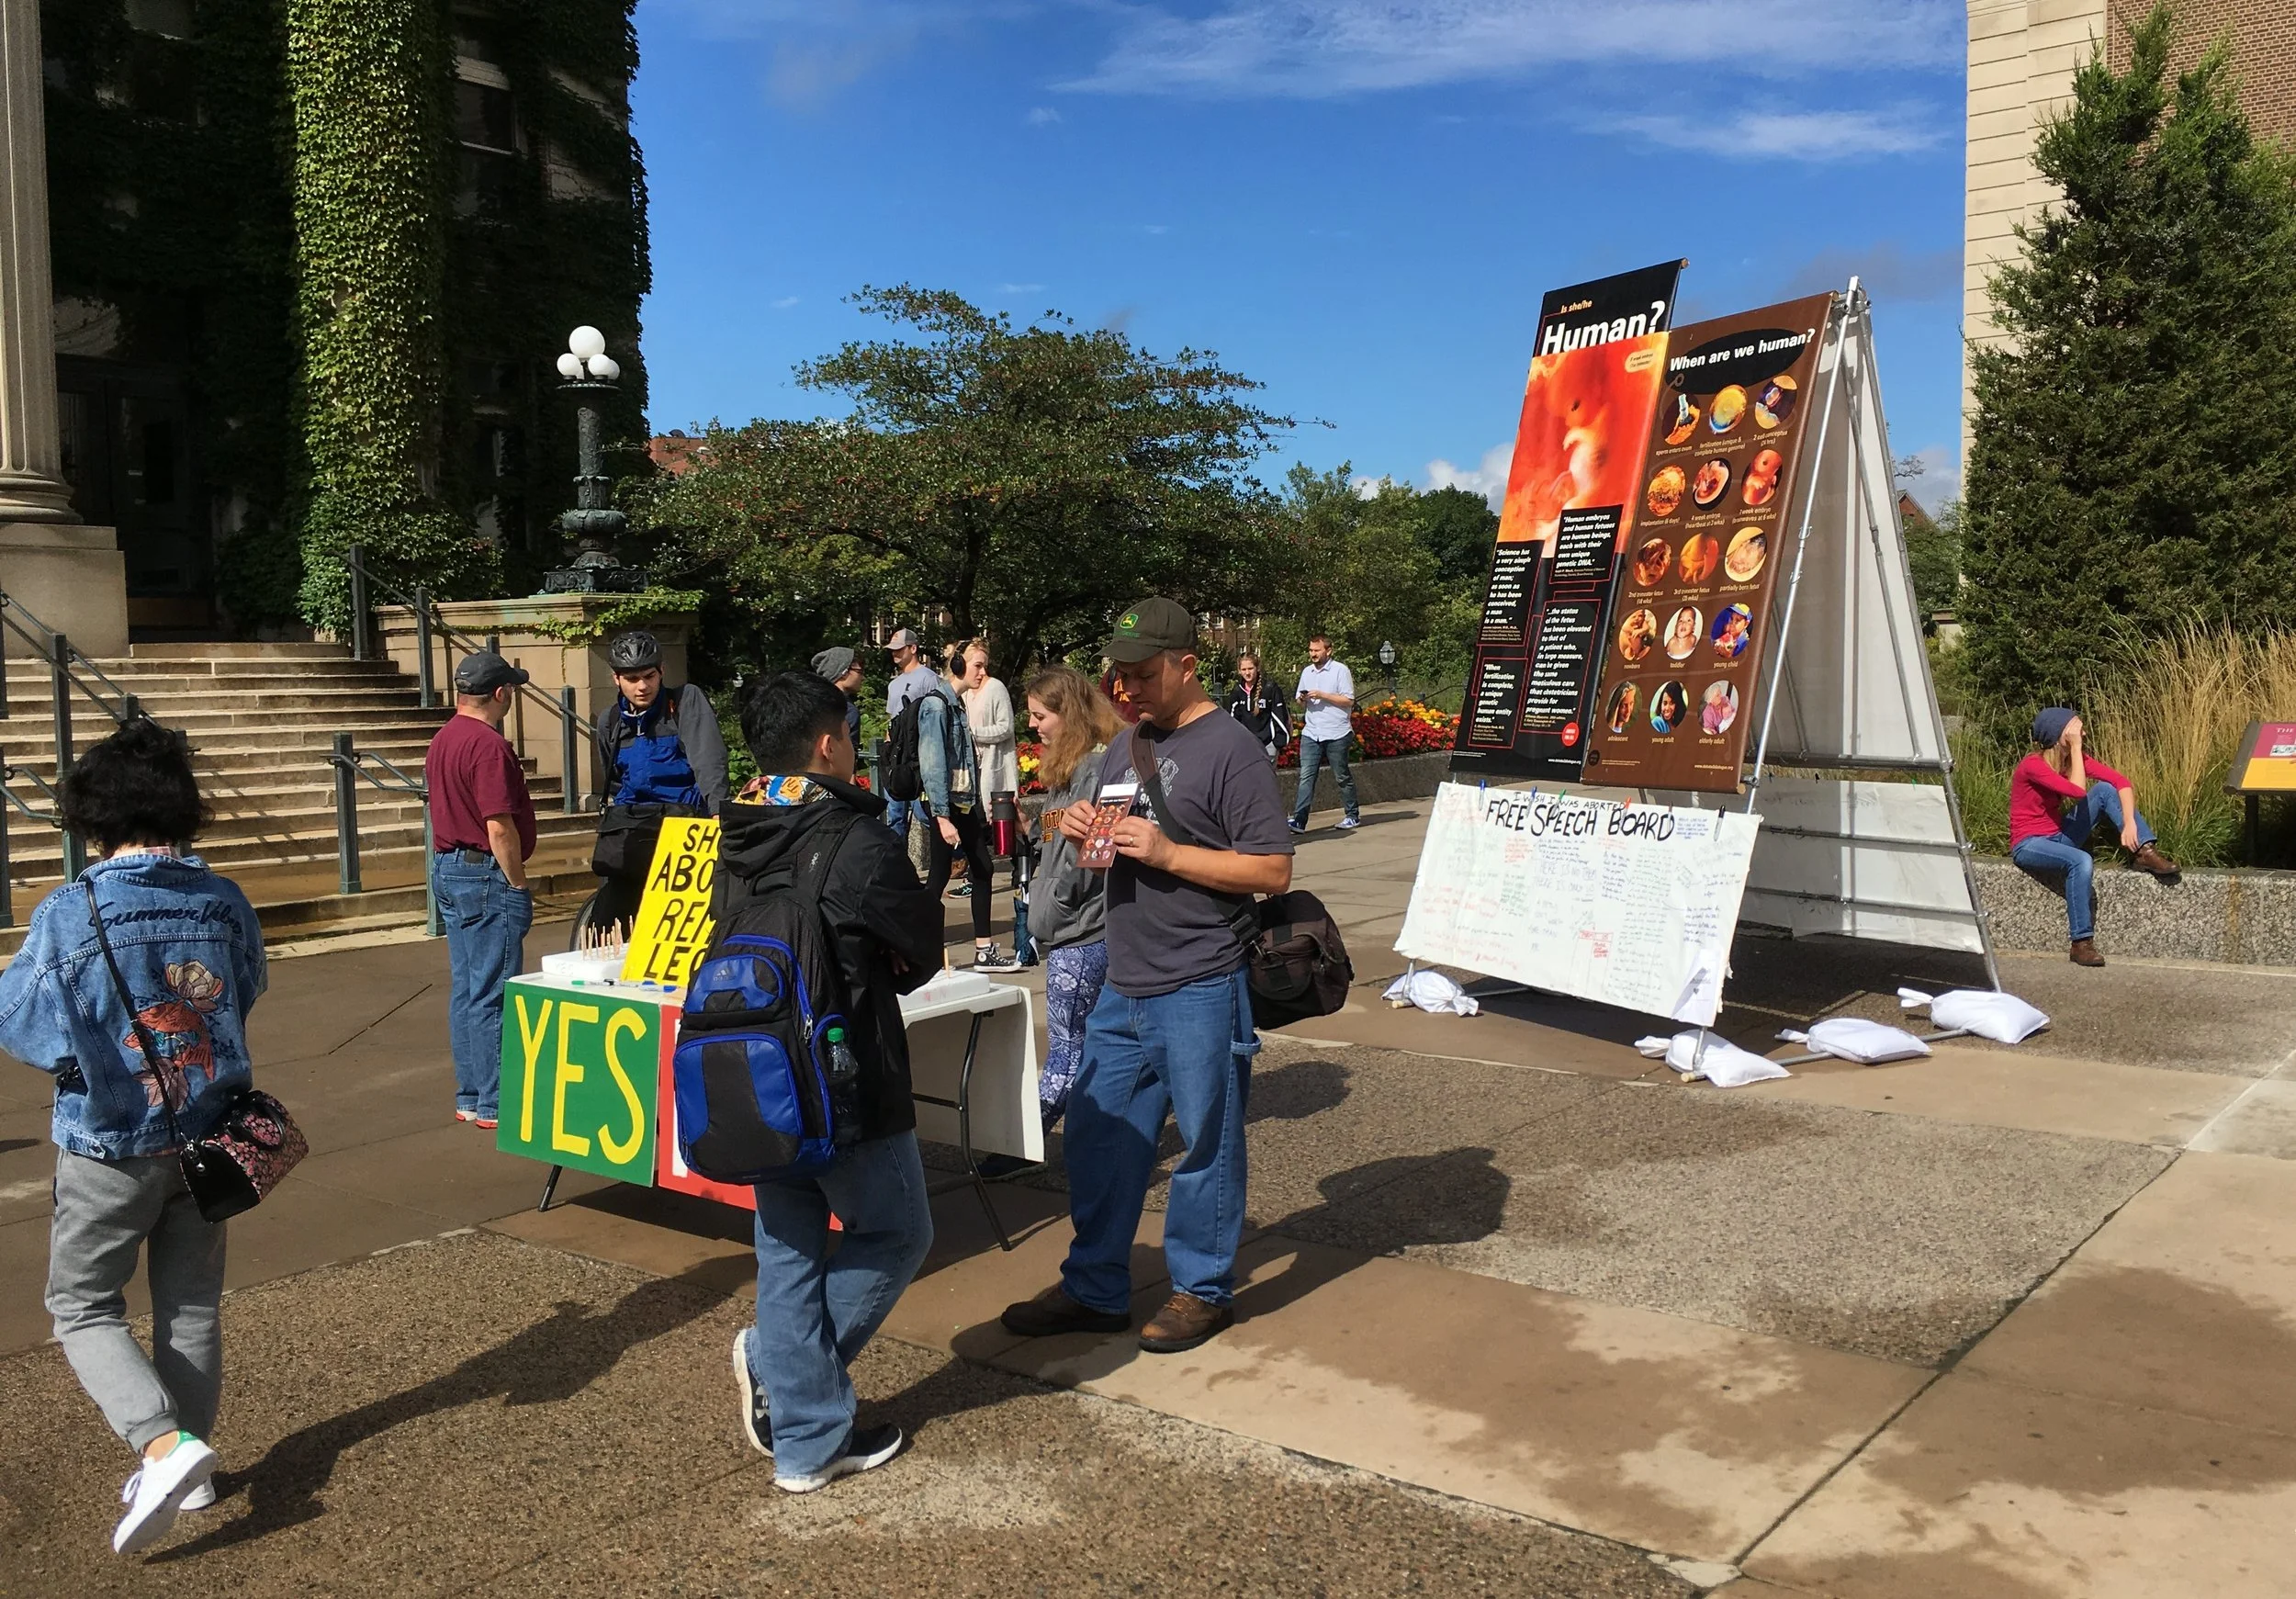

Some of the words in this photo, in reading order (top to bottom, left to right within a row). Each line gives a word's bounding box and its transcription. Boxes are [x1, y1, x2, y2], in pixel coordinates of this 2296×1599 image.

[1561, 305, 1567, 313] Is
[1569, 299, 1593, 311] she/he
[1541, 300, 1665, 356] Human?
[1670, 354, 1705, 372] When
[1709, 351, 1730, 364] are
[1734, 345, 1755, 359] we
[1758, 328, 1816, 354] human?
[1694, 449, 1713, 457] complete
[1556, 560, 1577, 569] genetic
[1496, 708, 1512, 716] entity
[1525, 706, 1550, 715] pregnant
[1514, 792, 1521, 801] I
[1583, 802, 1626, 810] ABORTED
[1486, 799, 1528, 831] FREE
[1531, 805, 1598, 837] SPEECH
[1608, 809, 1675, 841] BOARD
[683, 823, 720, 853] SH
[515, 994, 647, 1165] YES
